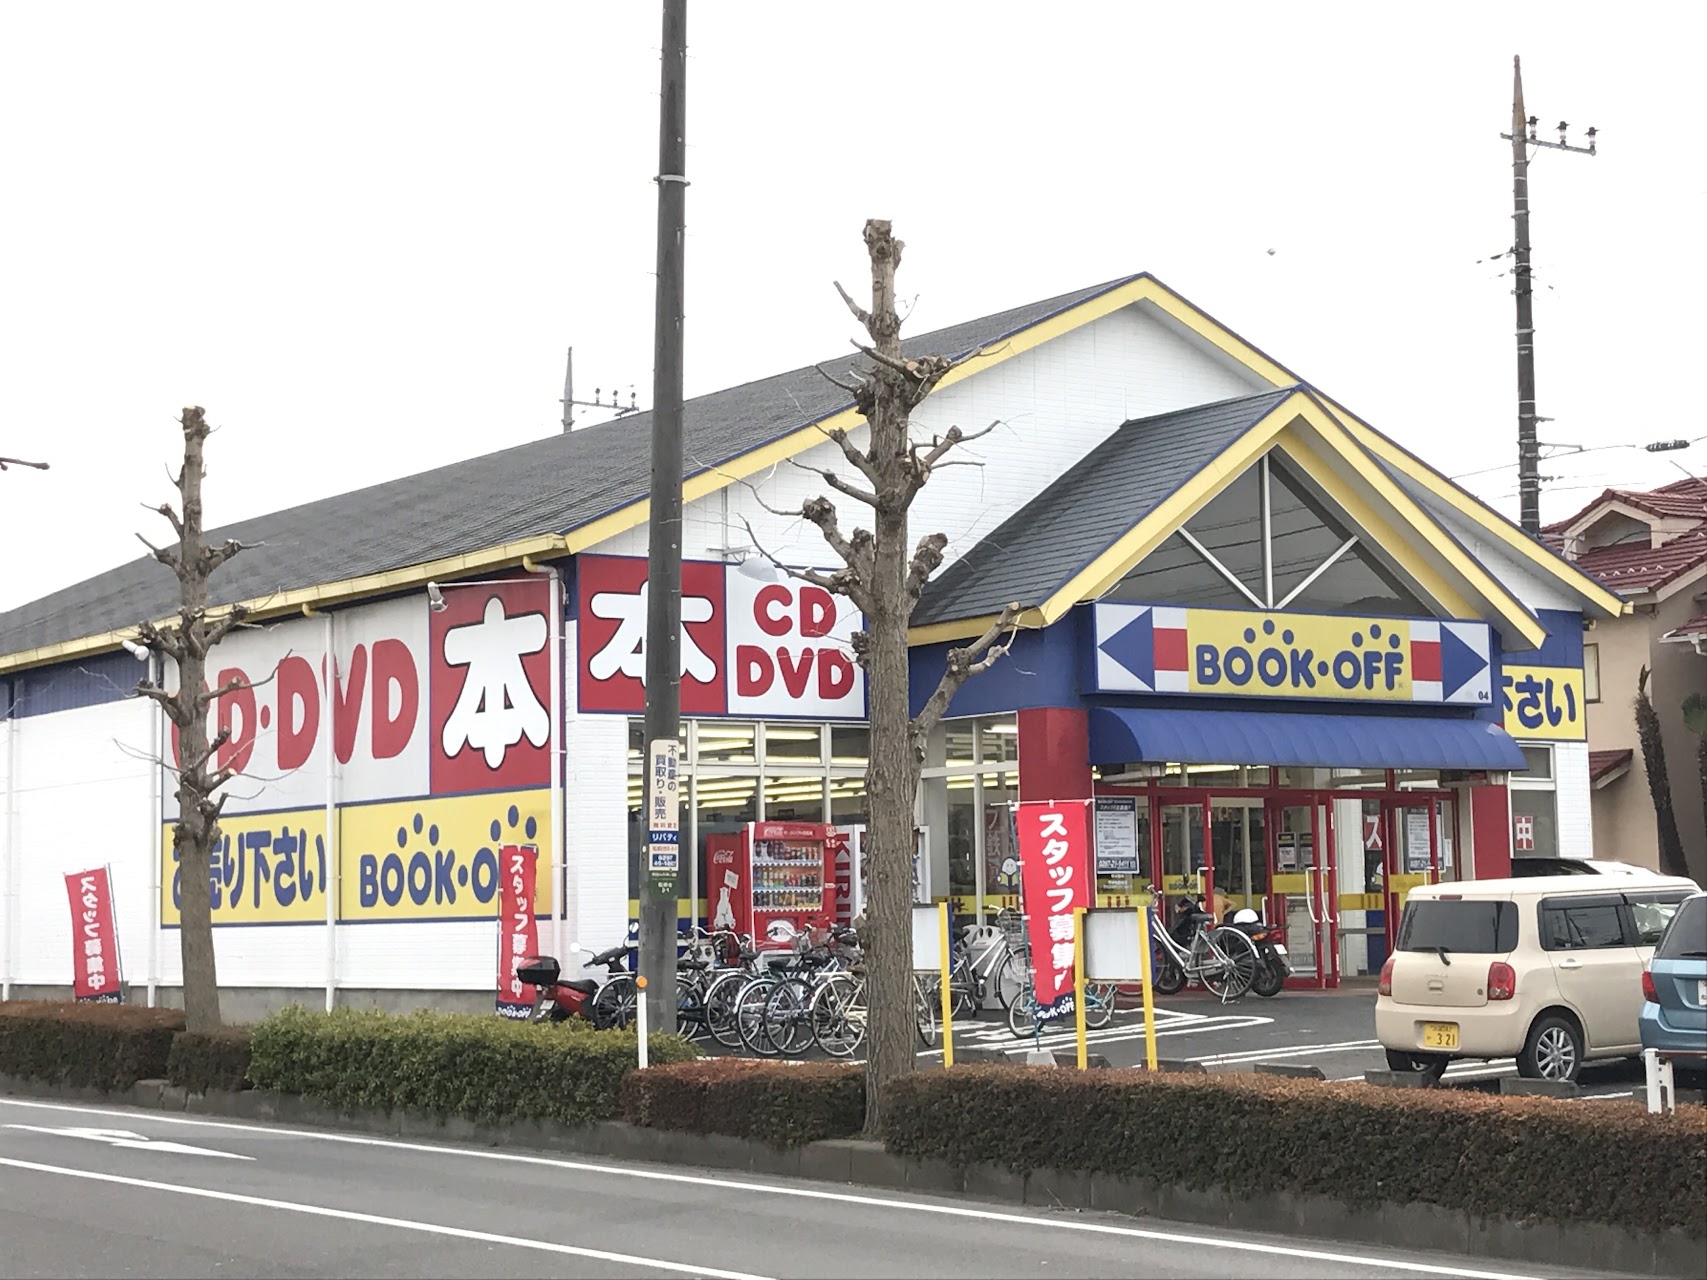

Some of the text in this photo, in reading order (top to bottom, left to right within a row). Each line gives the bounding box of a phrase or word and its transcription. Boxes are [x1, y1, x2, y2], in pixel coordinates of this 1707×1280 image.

[753, 584, 837, 637] CD
[442, 596, 551, 770] 本
[736, 644, 855, 699] DVD
[1478, 691, 1489, 700] 04
[1516, 817, 1532, 850] 中
